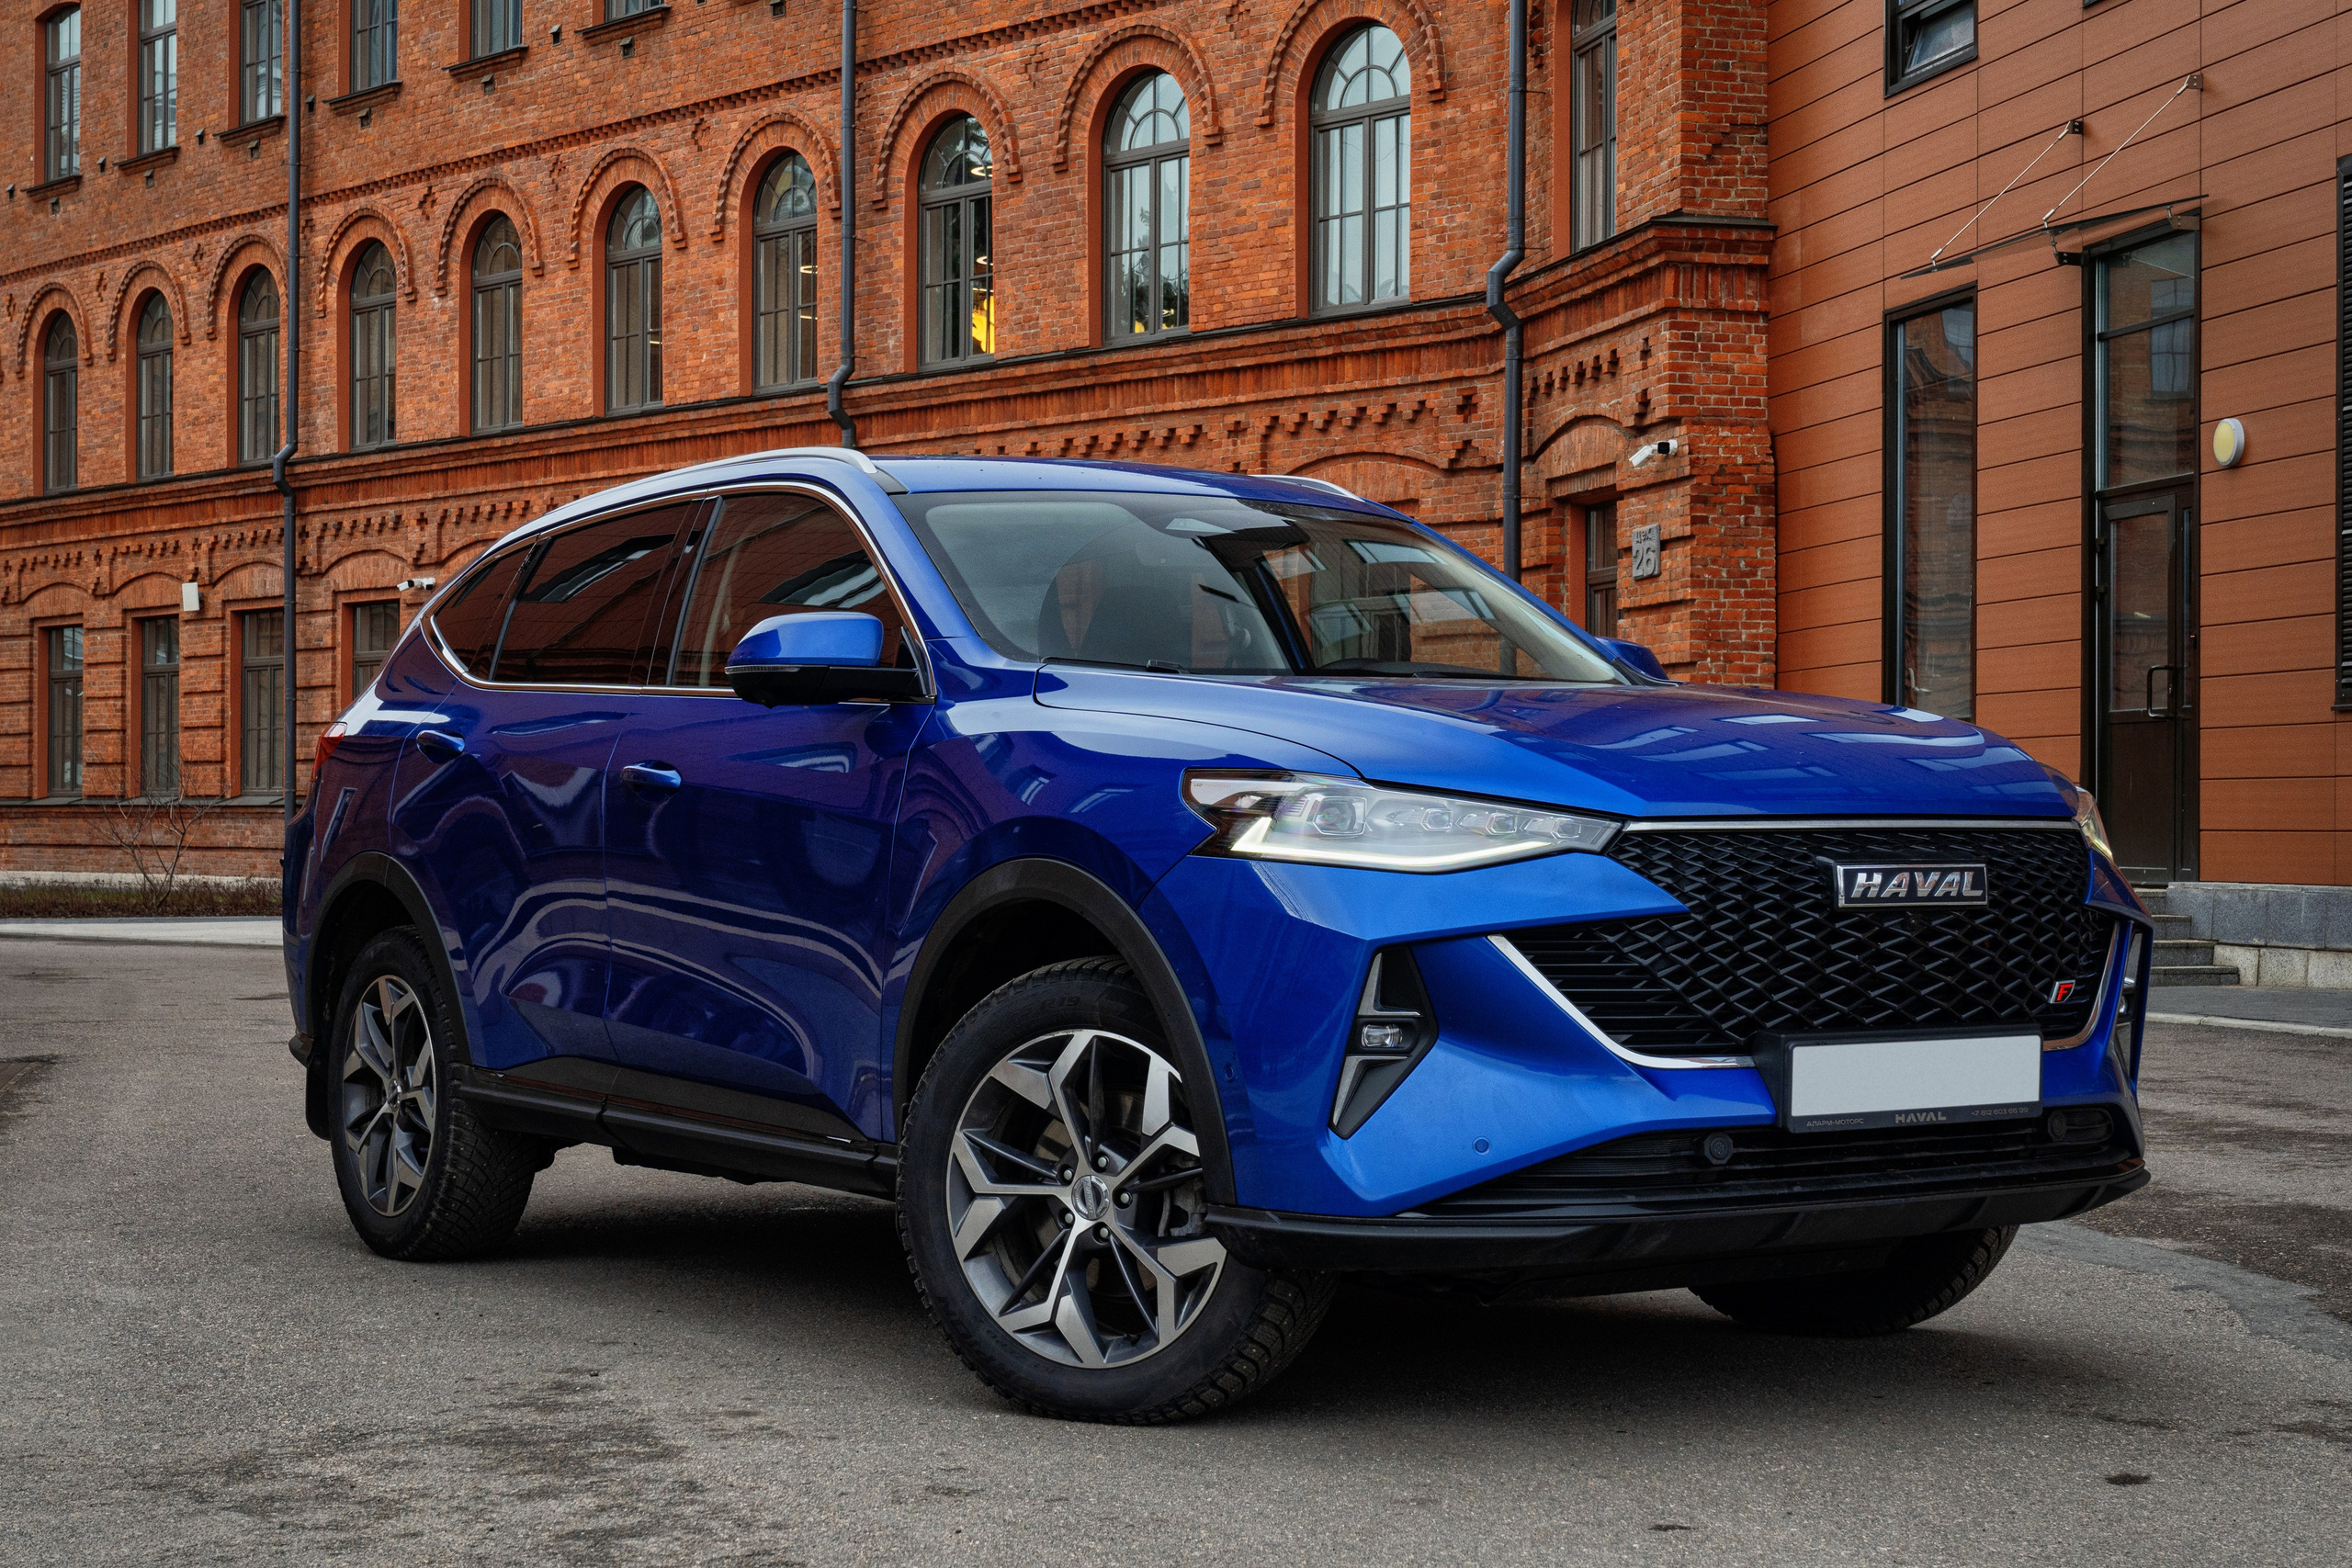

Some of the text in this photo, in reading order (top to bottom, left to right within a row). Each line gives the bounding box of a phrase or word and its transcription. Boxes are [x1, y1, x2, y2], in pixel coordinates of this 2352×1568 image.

[1633, 547, 1657, 578] 26
[1850, 871, 1984, 898] HAVAL
[2056, 983, 2074, 1001] F
[1806, 1118, 1864, 1127] АЛАРМ-МОТОРС
[1894, 1111, 1947, 1123] HAVAL
